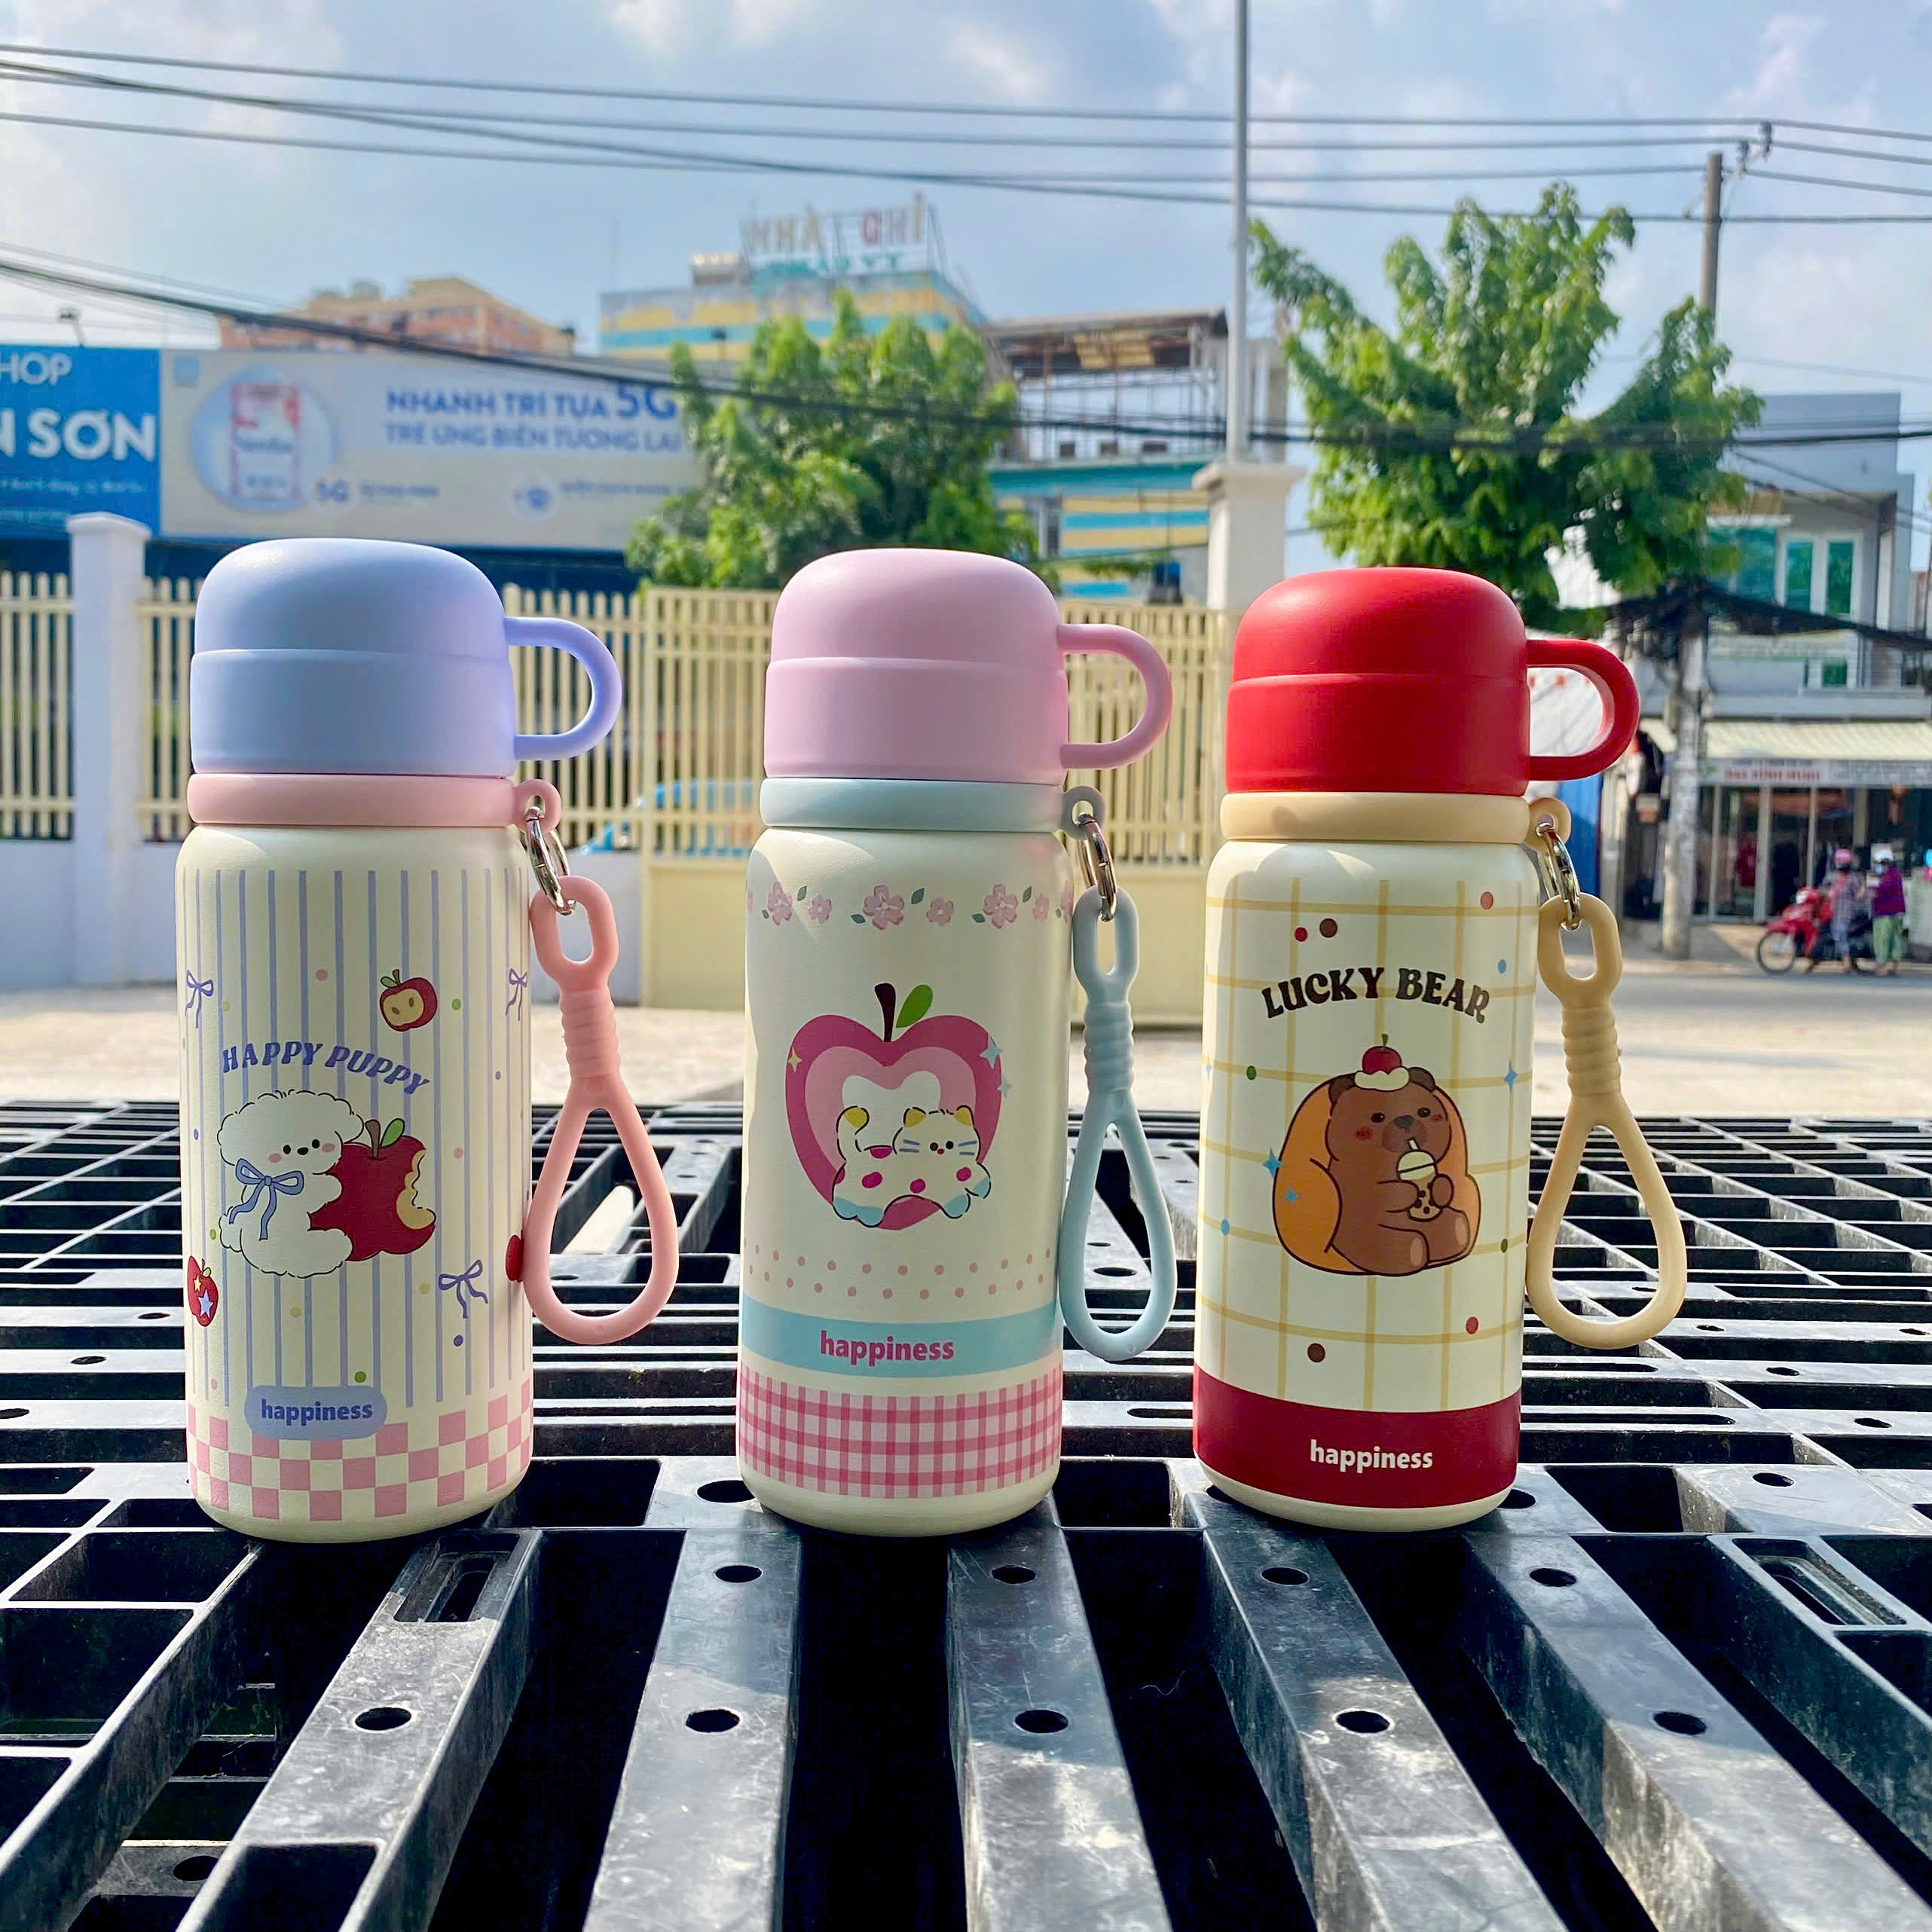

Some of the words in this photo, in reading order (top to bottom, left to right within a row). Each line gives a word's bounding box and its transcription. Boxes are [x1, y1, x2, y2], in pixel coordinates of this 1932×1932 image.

[27, 408, 156, 462] SƠN
[1261, 967, 1385, 1019] LUCKY
[1395, 968, 1490, 1023] BEAR
[222, 1041, 323, 1073] HAPPY
[324, 1045, 430, 1095] PUPPY
[820, 1329, 954, 1367] happiness
[261, 1398, 373, 1426] happiness
[1310, 1438, 1433, 1474] happiness
